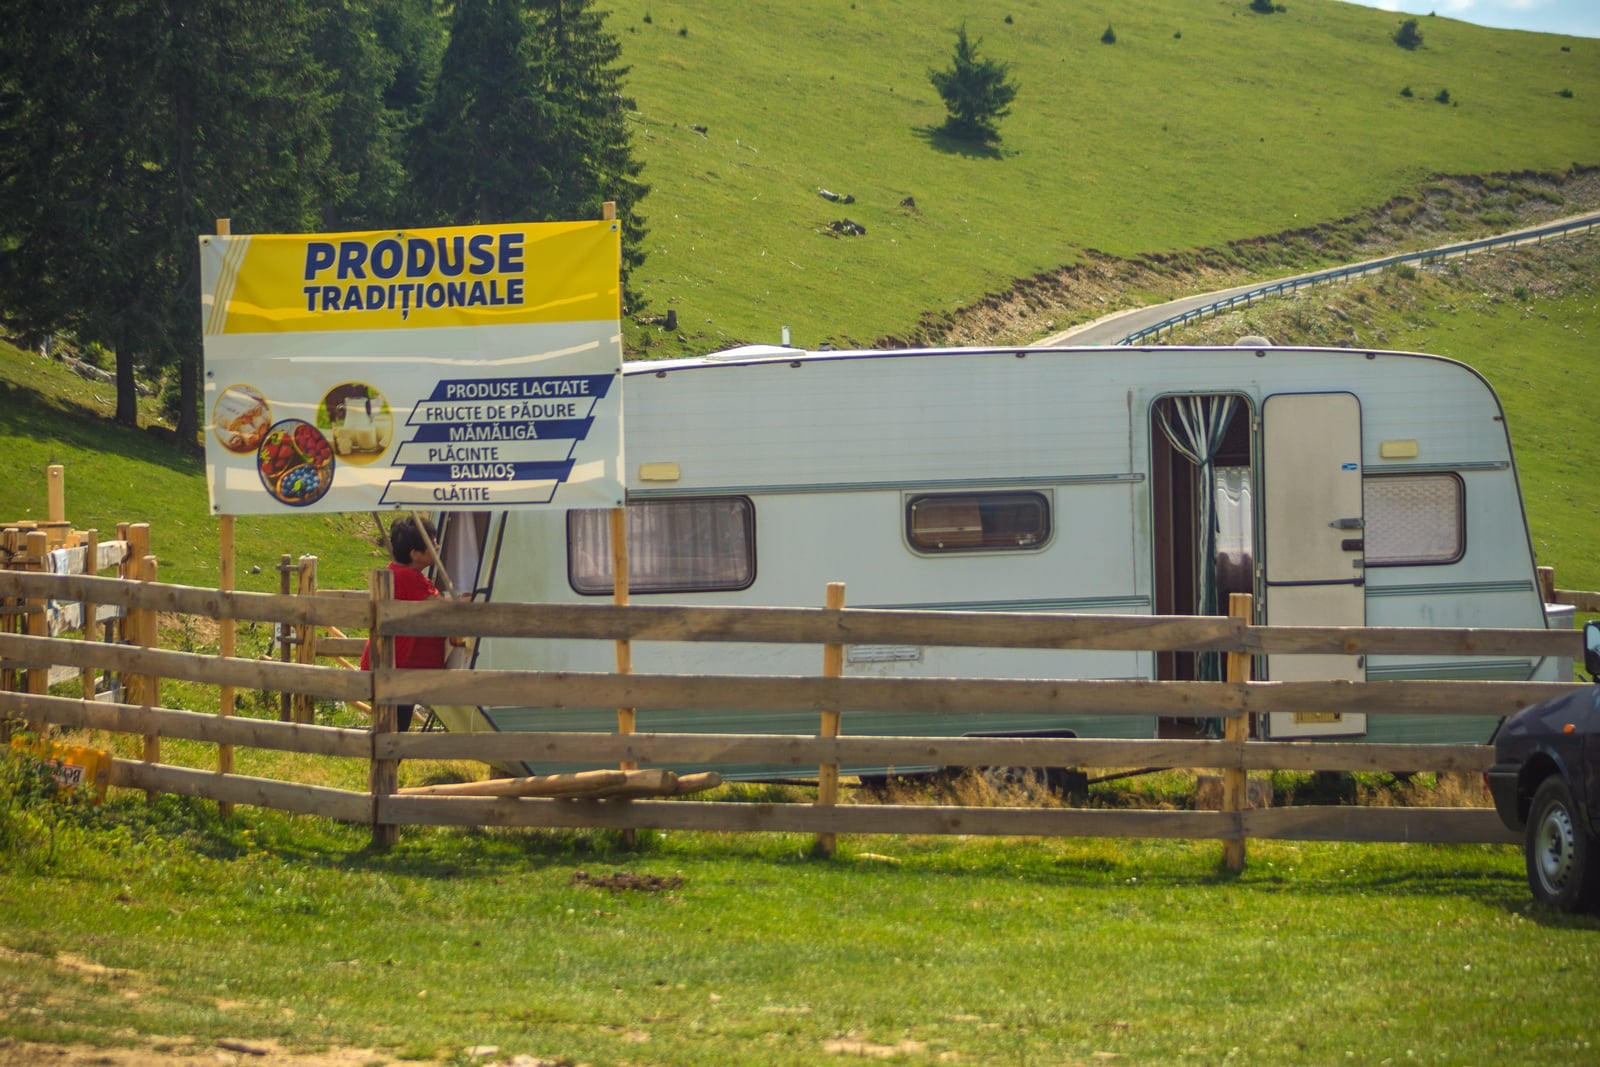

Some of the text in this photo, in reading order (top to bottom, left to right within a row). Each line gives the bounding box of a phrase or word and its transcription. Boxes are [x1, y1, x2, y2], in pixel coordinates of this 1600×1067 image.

[304, 233, 525, 281] PRODUSE
[303, 278, 524, 321] TRADIȚIONALE
[446, 379, 589, 399] PRODUSE LACTATE
[426, 401, 576, 421] FRUCTE DE PĂDURE
[450, 422, 538, 441] MĂMĂLIGĂ
[428, 444, 499, 462] PLĂCINTE
[451, 463, 515, 481] BALMOȘ
[433, 484, 490, 501] CLĂTITE
